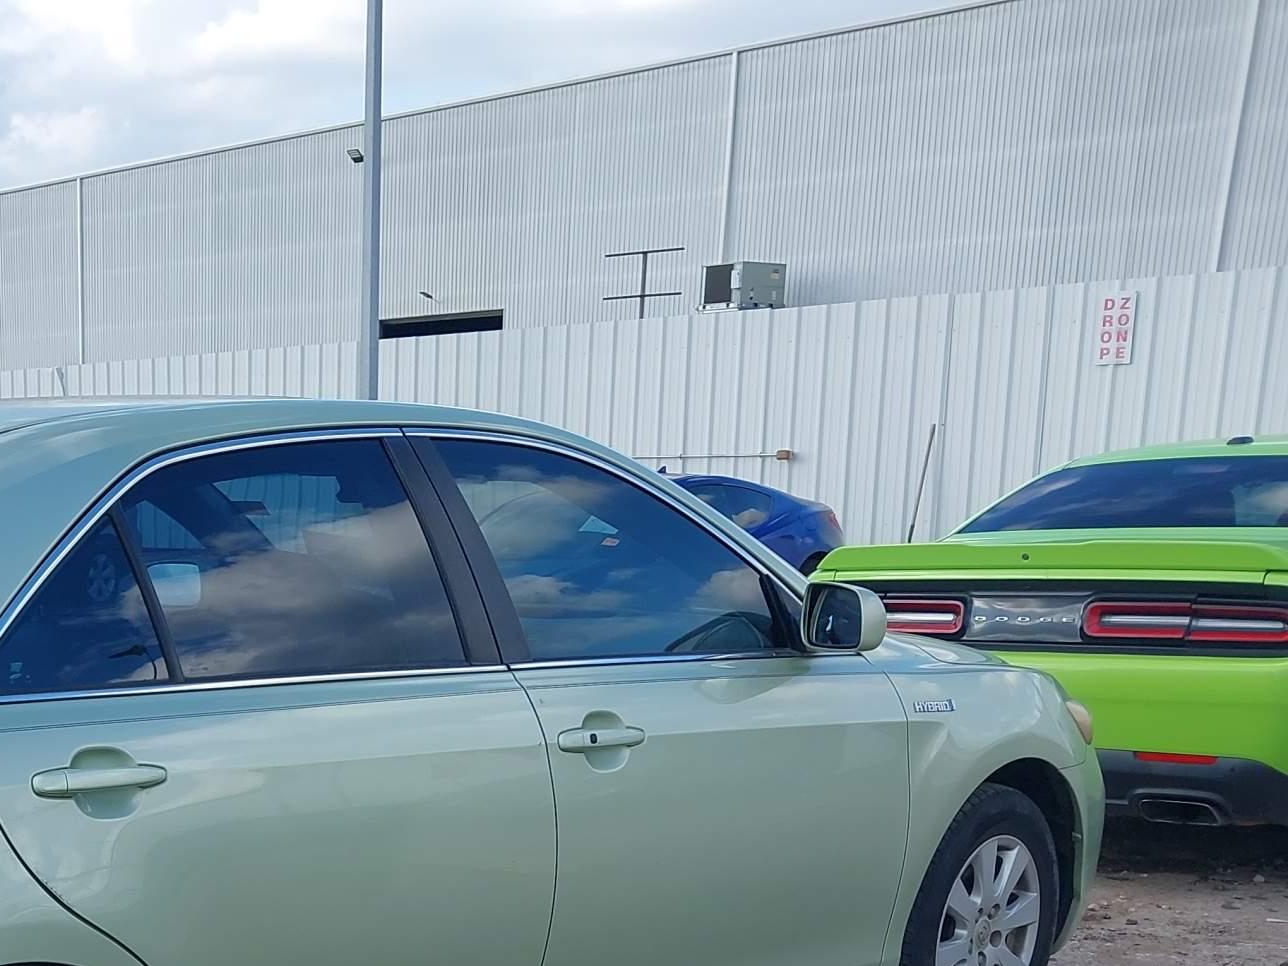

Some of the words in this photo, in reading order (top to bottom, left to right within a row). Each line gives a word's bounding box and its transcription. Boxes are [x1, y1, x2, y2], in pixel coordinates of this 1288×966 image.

[1099, 298, 1115, 360] DROP
[1115, 296, 1131, 359] ZONE
[974, 615, 1075, 624] DODGE
[913, 700, 950, 713] HYBRID
